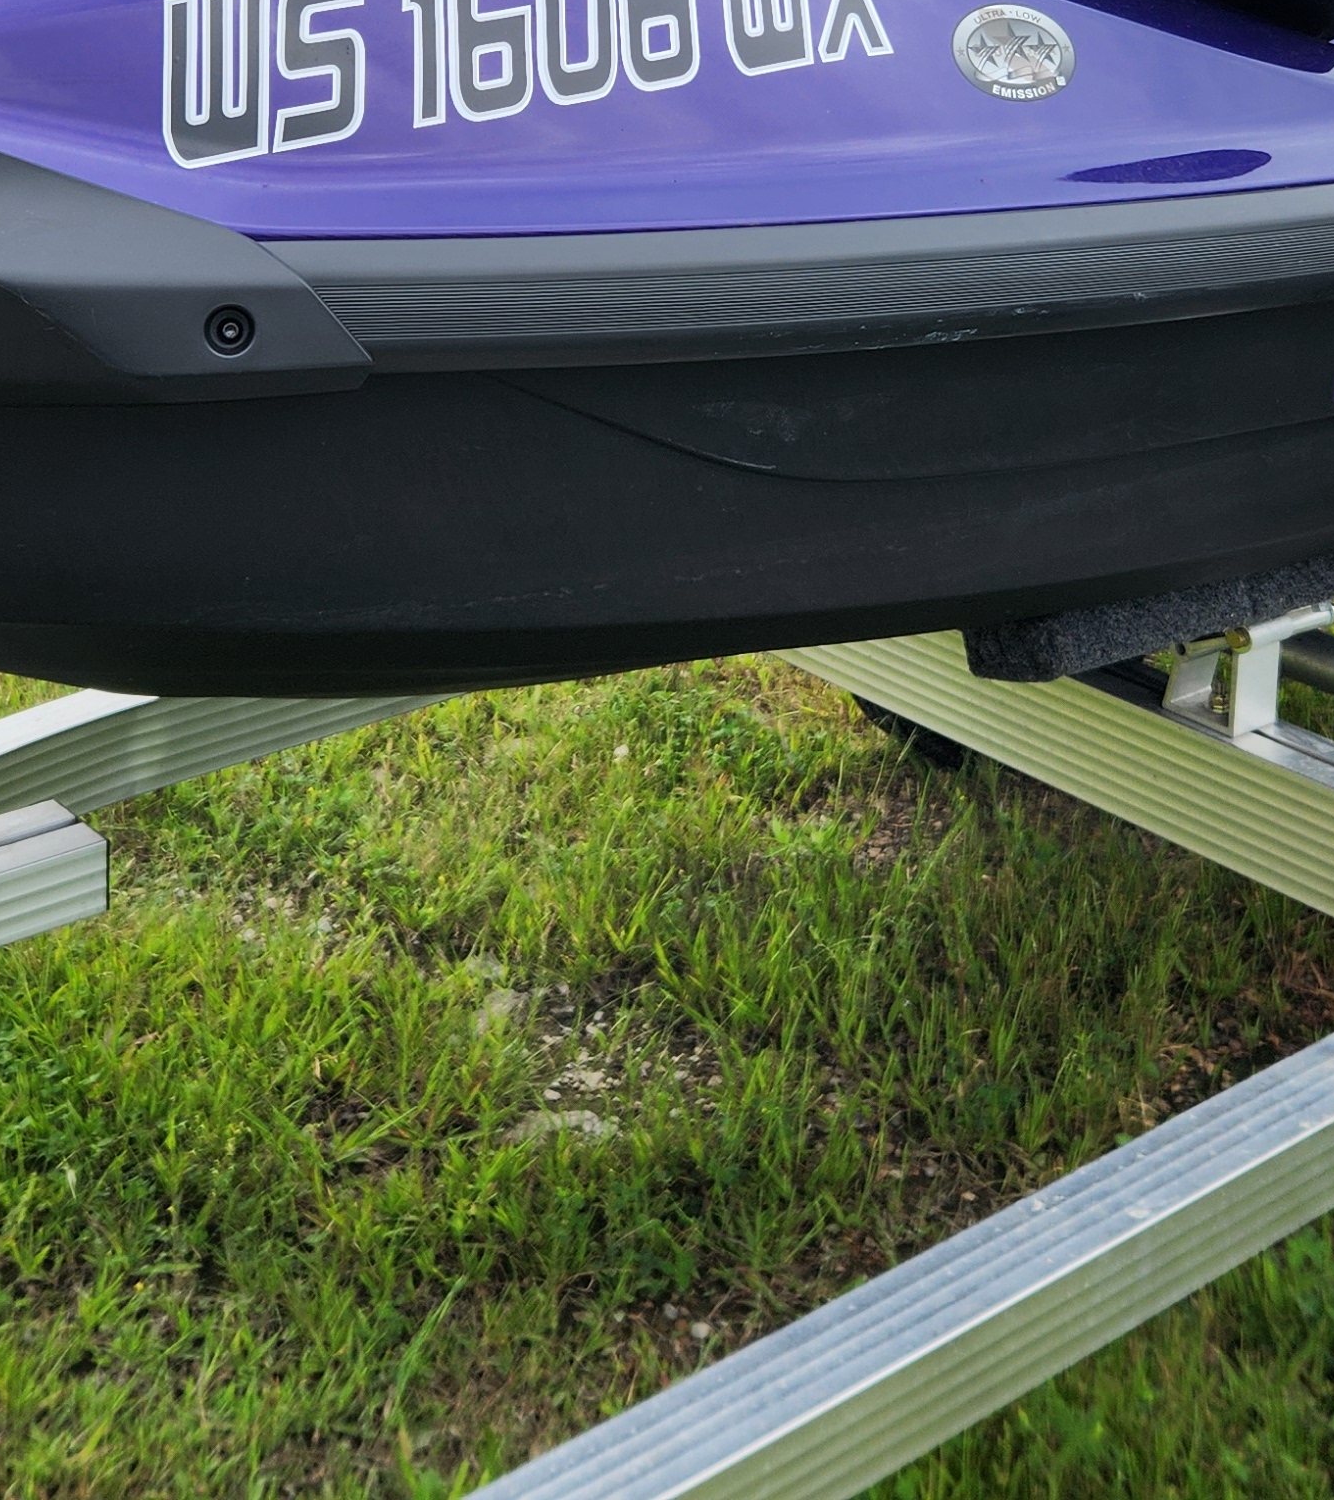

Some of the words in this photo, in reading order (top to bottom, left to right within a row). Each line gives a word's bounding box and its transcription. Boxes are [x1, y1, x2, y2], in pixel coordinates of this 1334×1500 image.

[973, 9, 1007, 25] ULTRA
[1015, 10, 1042, 24] LOW
[992, 83, 1056, 100] EMISSION
